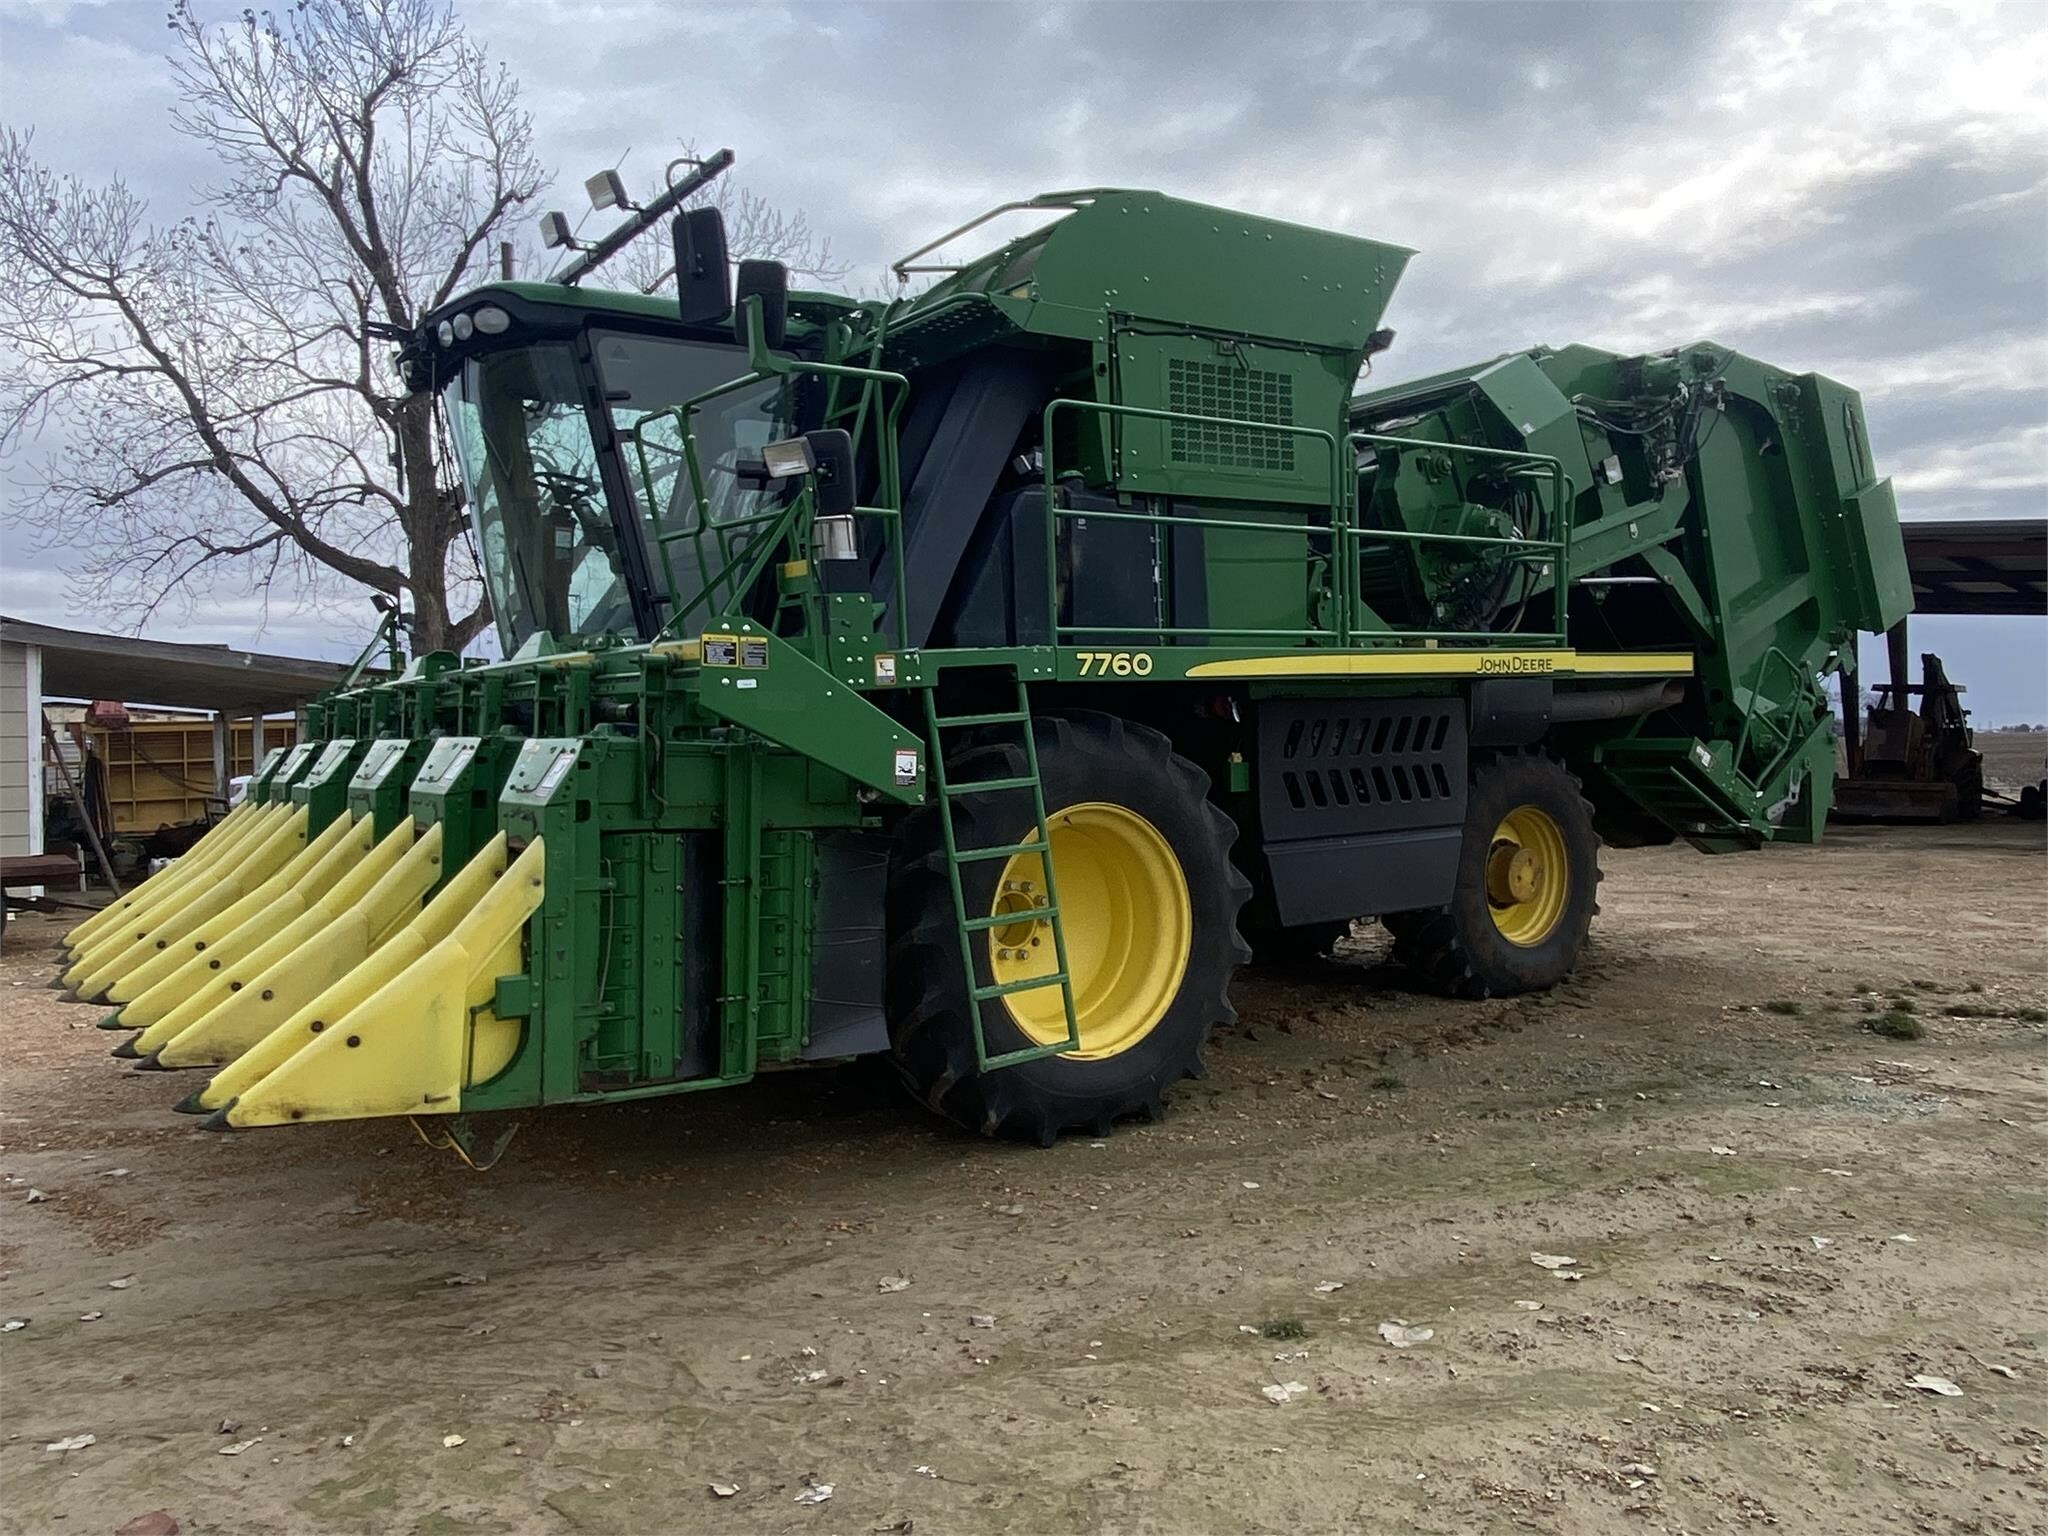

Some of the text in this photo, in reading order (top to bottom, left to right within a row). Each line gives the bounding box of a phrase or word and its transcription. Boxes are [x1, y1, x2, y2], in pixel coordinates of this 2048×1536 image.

[1076, 652, 1153, 676] 7760
[1477, 656, 1553, 672] JOHN DEERE
